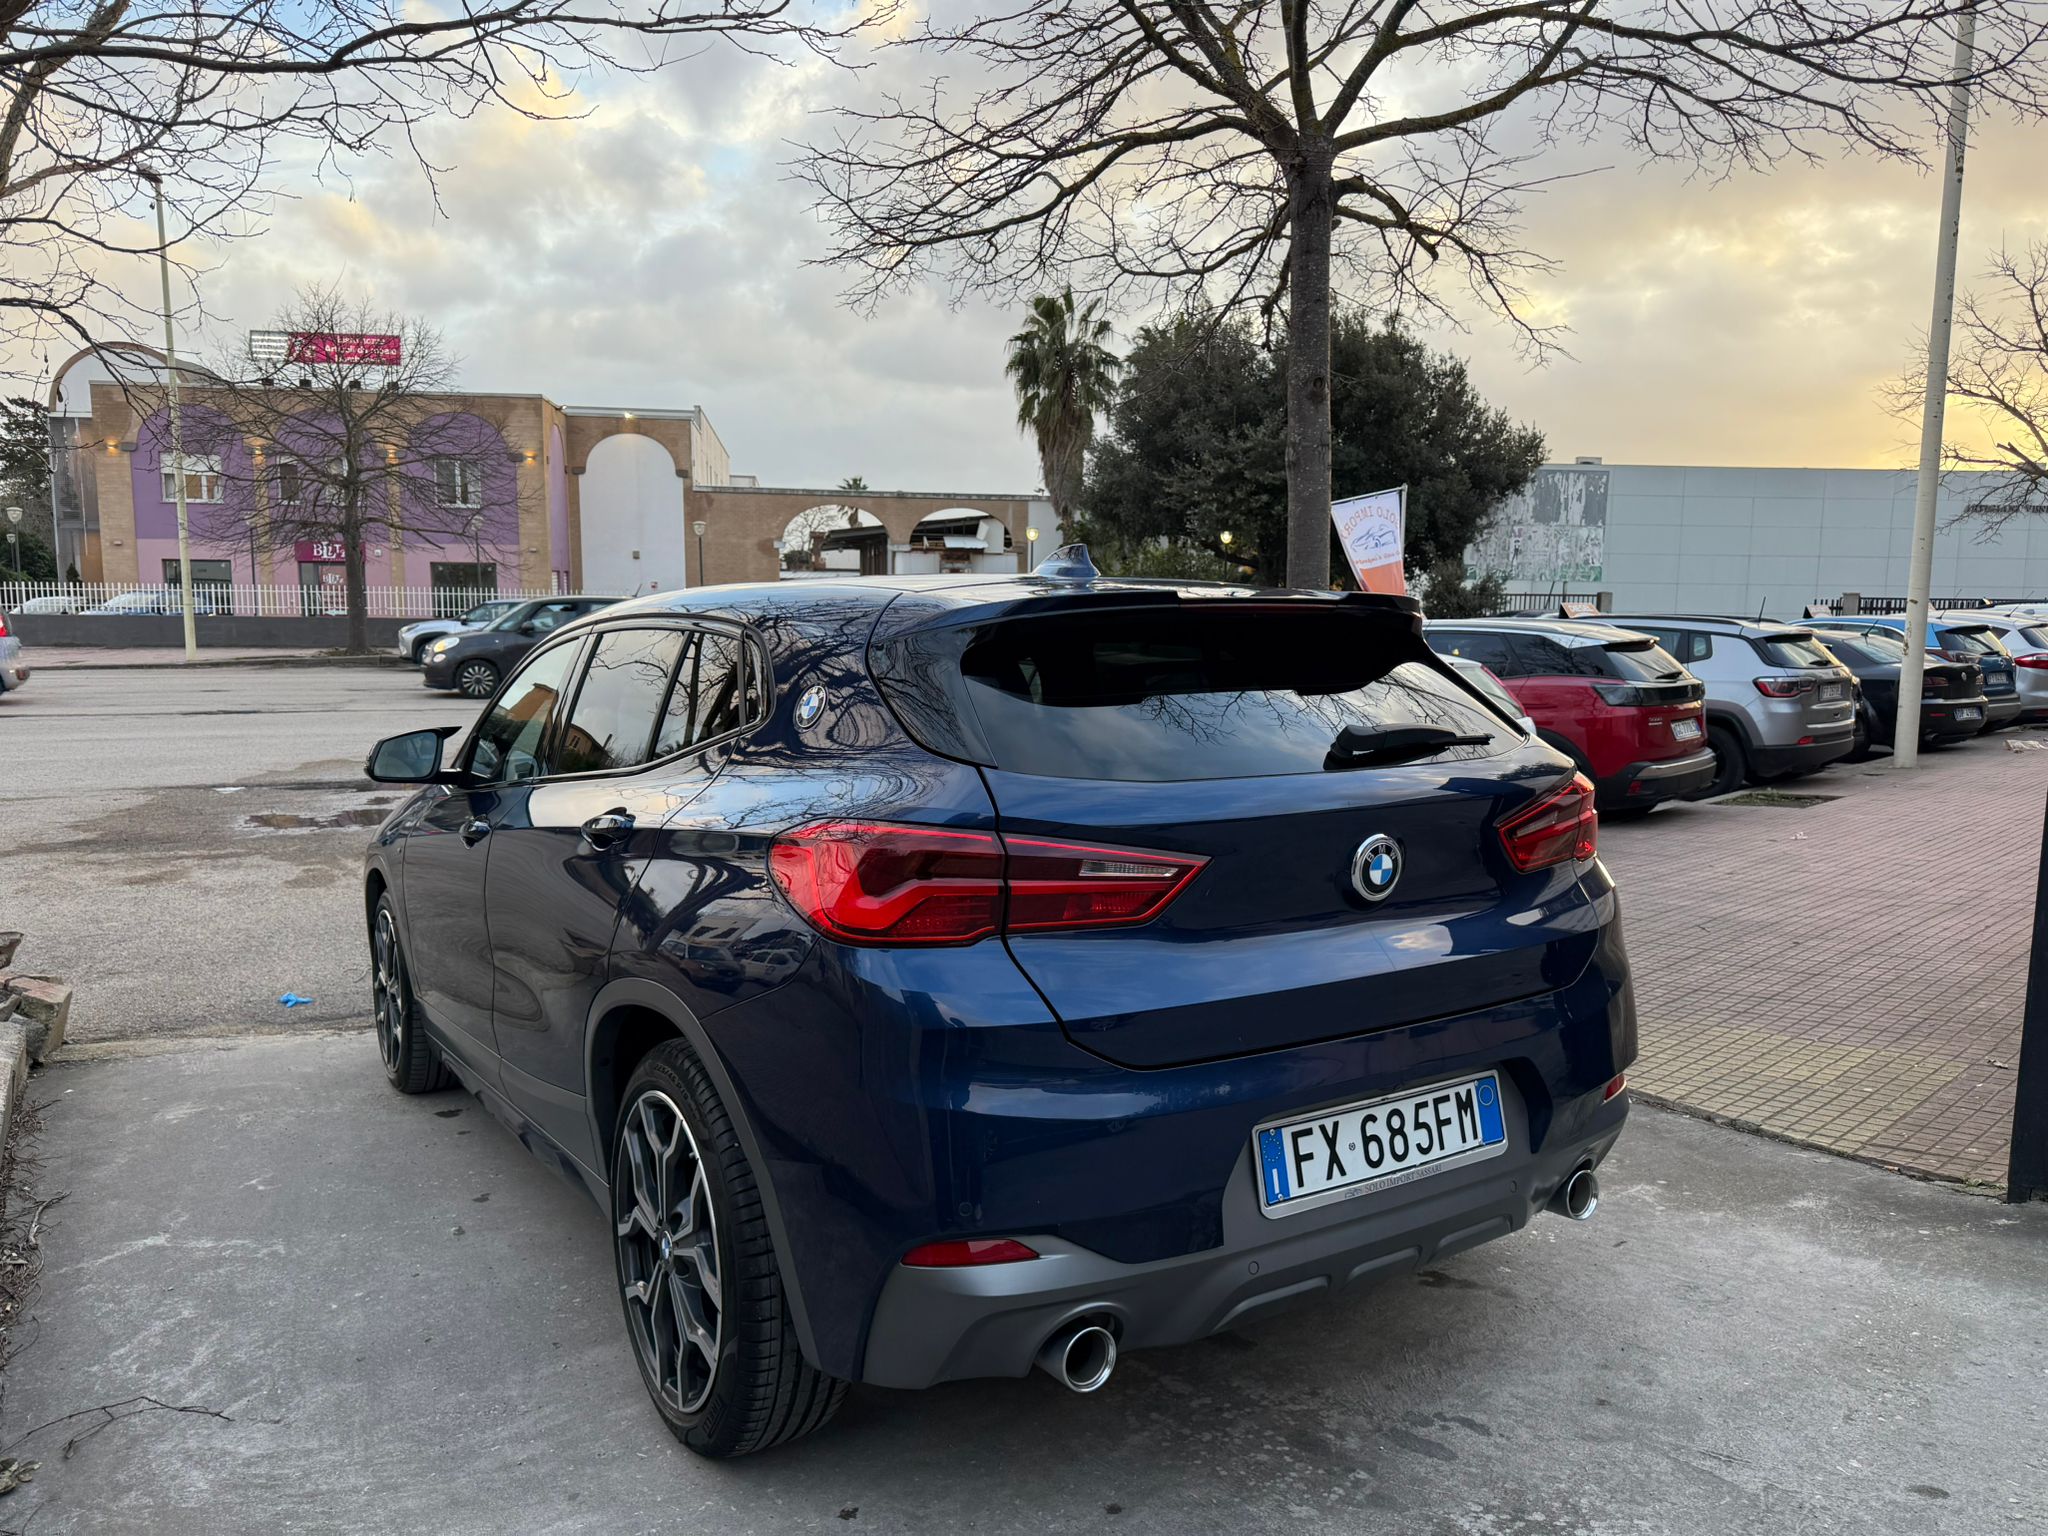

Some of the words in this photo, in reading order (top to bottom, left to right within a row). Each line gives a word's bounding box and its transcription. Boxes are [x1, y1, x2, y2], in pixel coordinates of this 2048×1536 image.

[1291, 1120, 1348, 1188] FX
[1360, 1087, 1479, 1169] 685FM
[1364, 1179, 1386, 1195] SOLO
[1386, 1171, 1417, 1189] IMPORT
[1416, 1163, 1443, 1182] SASSARI
